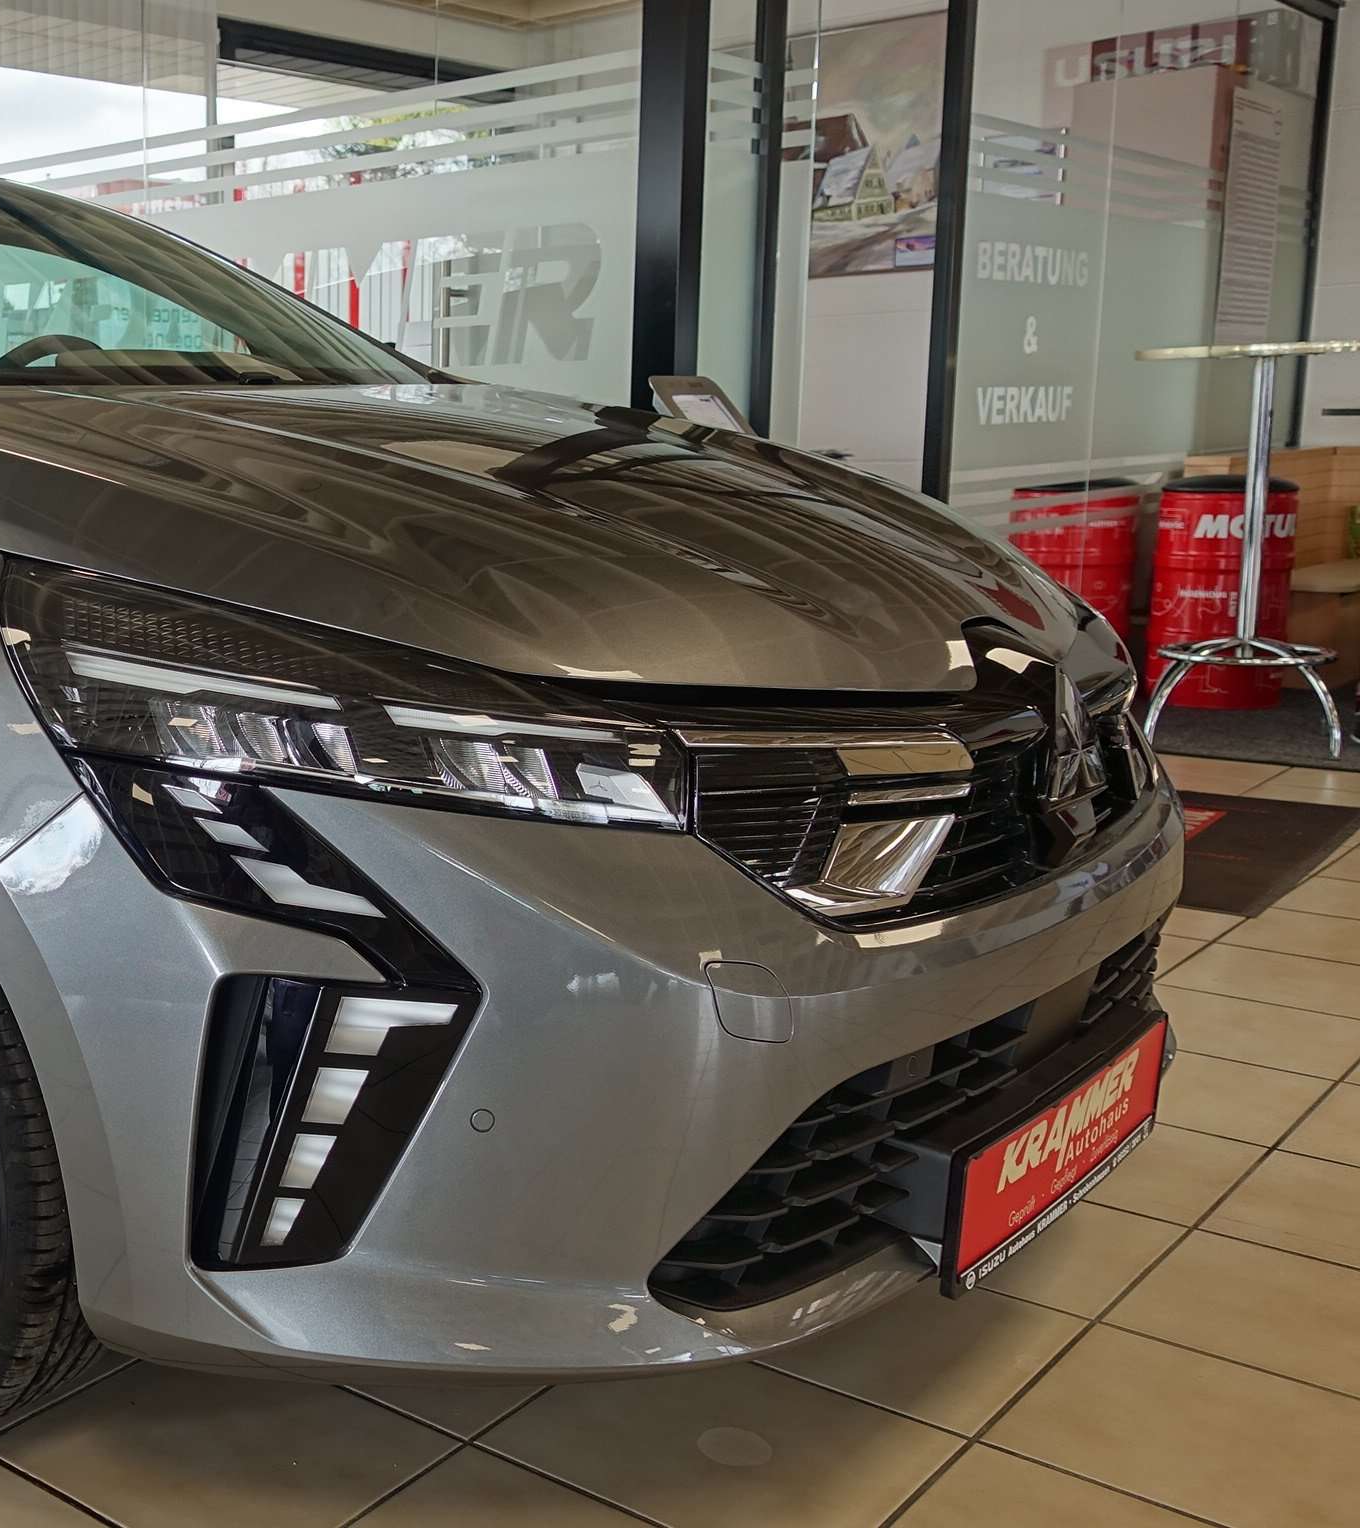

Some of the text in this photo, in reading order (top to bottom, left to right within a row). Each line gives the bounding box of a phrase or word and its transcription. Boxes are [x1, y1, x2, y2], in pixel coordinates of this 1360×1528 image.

[977, 241, 1088, 287] BERATUNG
[1024, 316, 1038, 354] &
[977, 386, 1072, 425] VERKAUF
[997, 1048, 1139, 1194] KRAMMER
[1064, 1098, 1129, 1167] Autohaus
[978, 1250, 1006, 1279] ISUZU
[1008, 1230, 1035, 1257] Autohaus
[1037, 1200, 1068, 1234] KRAMMER
